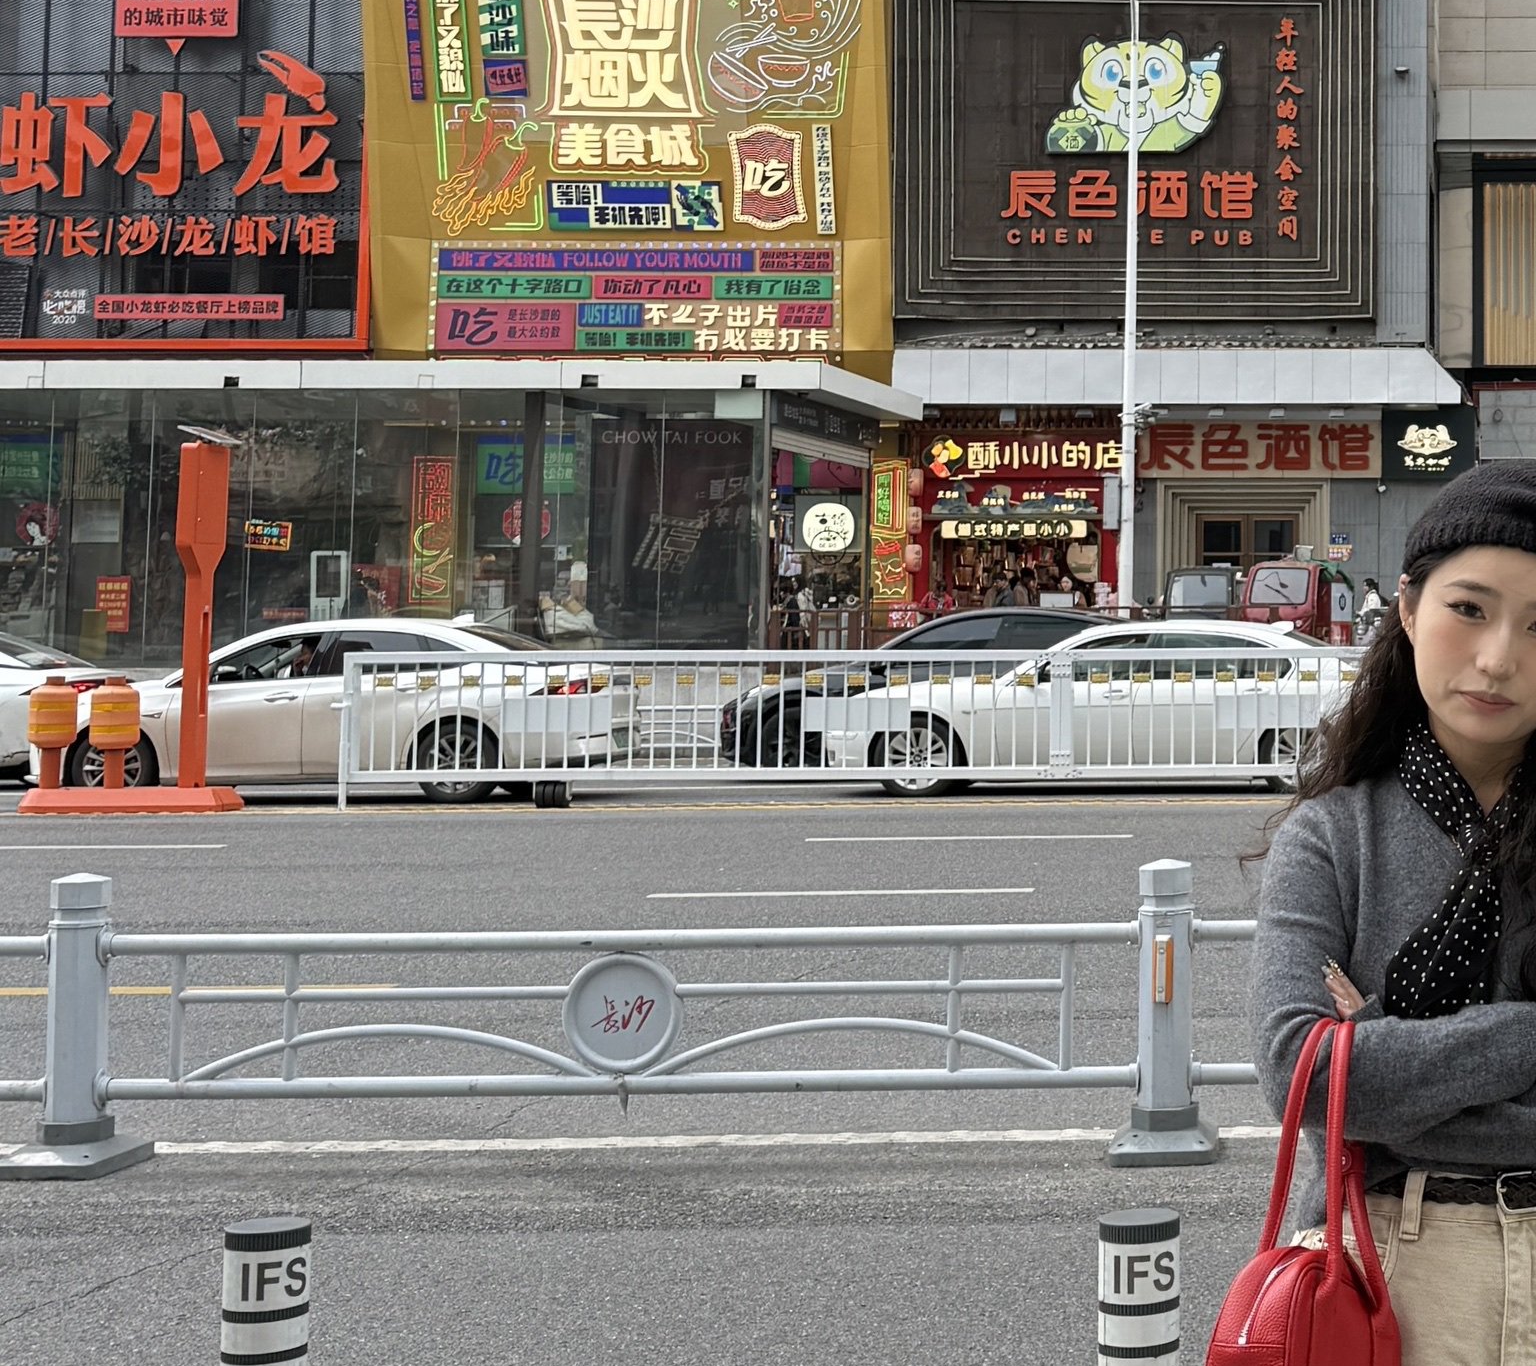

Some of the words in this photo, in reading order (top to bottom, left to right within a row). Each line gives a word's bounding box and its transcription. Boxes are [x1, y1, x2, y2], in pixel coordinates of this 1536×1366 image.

[123, 7, 229, 26] 的城市味觉
[561, 50, 689, 108] 烟火
[0, 60, 340, 198] 虾小龙
[1275, 17, 1304, 241] 年轻人的聚会空间
[557, 123, 699, 166] 美食城
[1065, 136, 1080, 149] 酒
[744, 159, 790, 197] 吃
[1001, 170, 1258, 220] 辰色酒馆
[1006, 228, 1093, 245] CHEN
[1135, 229, 1164, 245] E
[1190, 229, 1253, 245] PUB
[563, 251, 629, 267] FOLLOW
[634, 252, 681, 268] YOUR
[684, 252, 742, 268] MOUTH
[446, 278, 582, 295] 在这个十字路口
[603, 278, 701, 295] 你动了凡心
[724, 279, 822, 296] 我有了俗念
[97, 298, 279, 315] 全国小龙虾必吃餐厅上榜品牌
[581, 305, 606, 325] JUST
[607, 305, 627, 324] EAT
[52, 315, 77, 324] 2020
[448, 307, 498, 346] 吃
[602, 430, 658, 444] CHOW
[664, 430, 689, 444] TAI
[695, 430, 742, 444] FOOK
[1139, 423, 1375, 471] 辰色酒馆
[967, 440, 1122, 471] 酥小小的店
[241, 1256, 307, 1302] IFS
[1113, 1250, 1175, 1295] IFS
